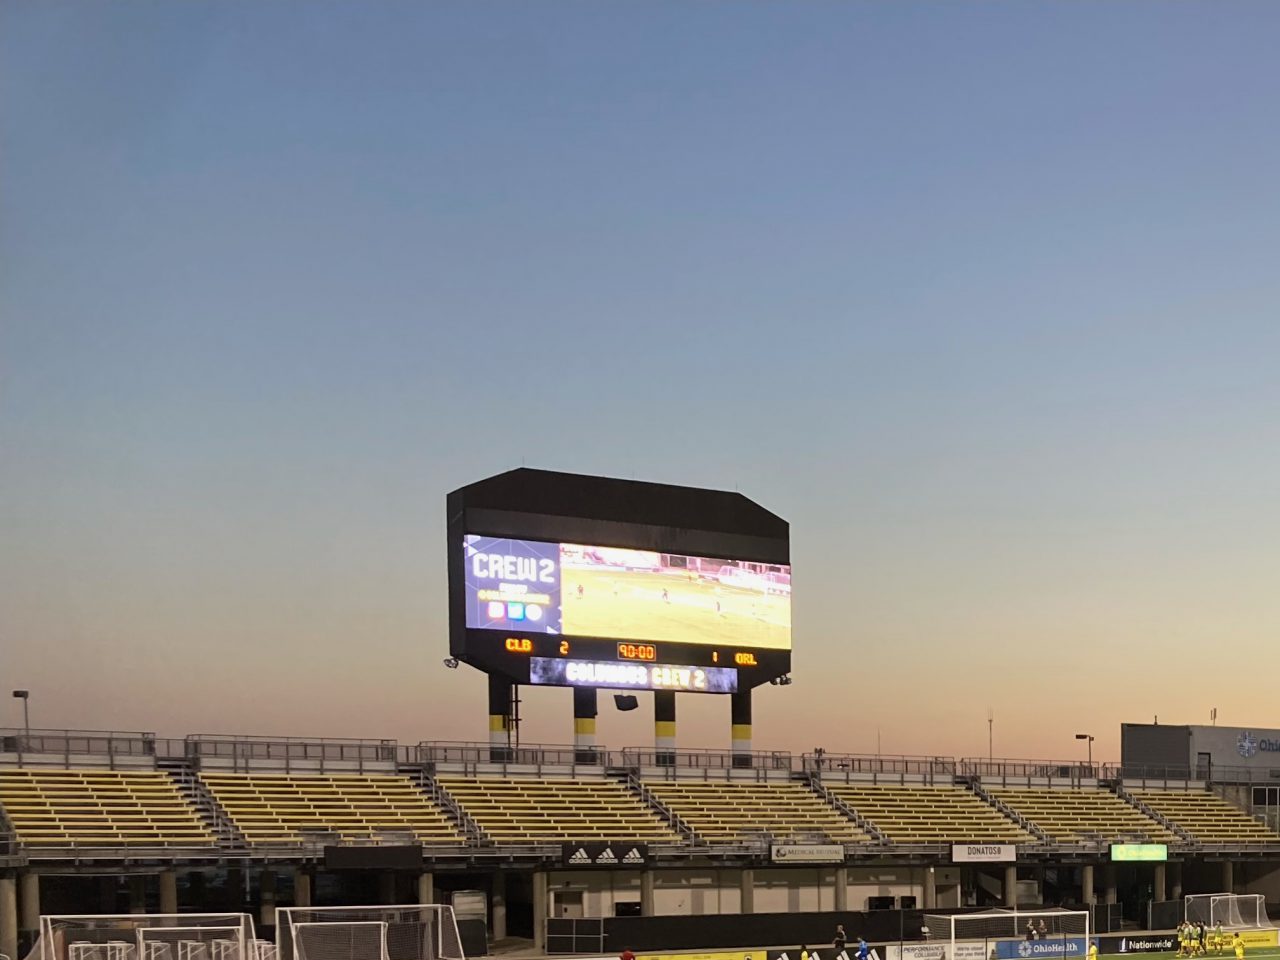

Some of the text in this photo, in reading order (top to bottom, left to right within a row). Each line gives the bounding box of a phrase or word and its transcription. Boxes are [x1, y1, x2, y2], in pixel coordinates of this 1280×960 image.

[473, 553, 555, 583] CREW 2
[506, 638, 532, 652] CLB
[560, 641, 569, 654] 2
[619, 644, 655, 659] 90:00
[694, 669, 705, 688] 2
[1033, 943, 1078, 953] OhioHealth
[1129, 939, 1171, 949] Nationwide
